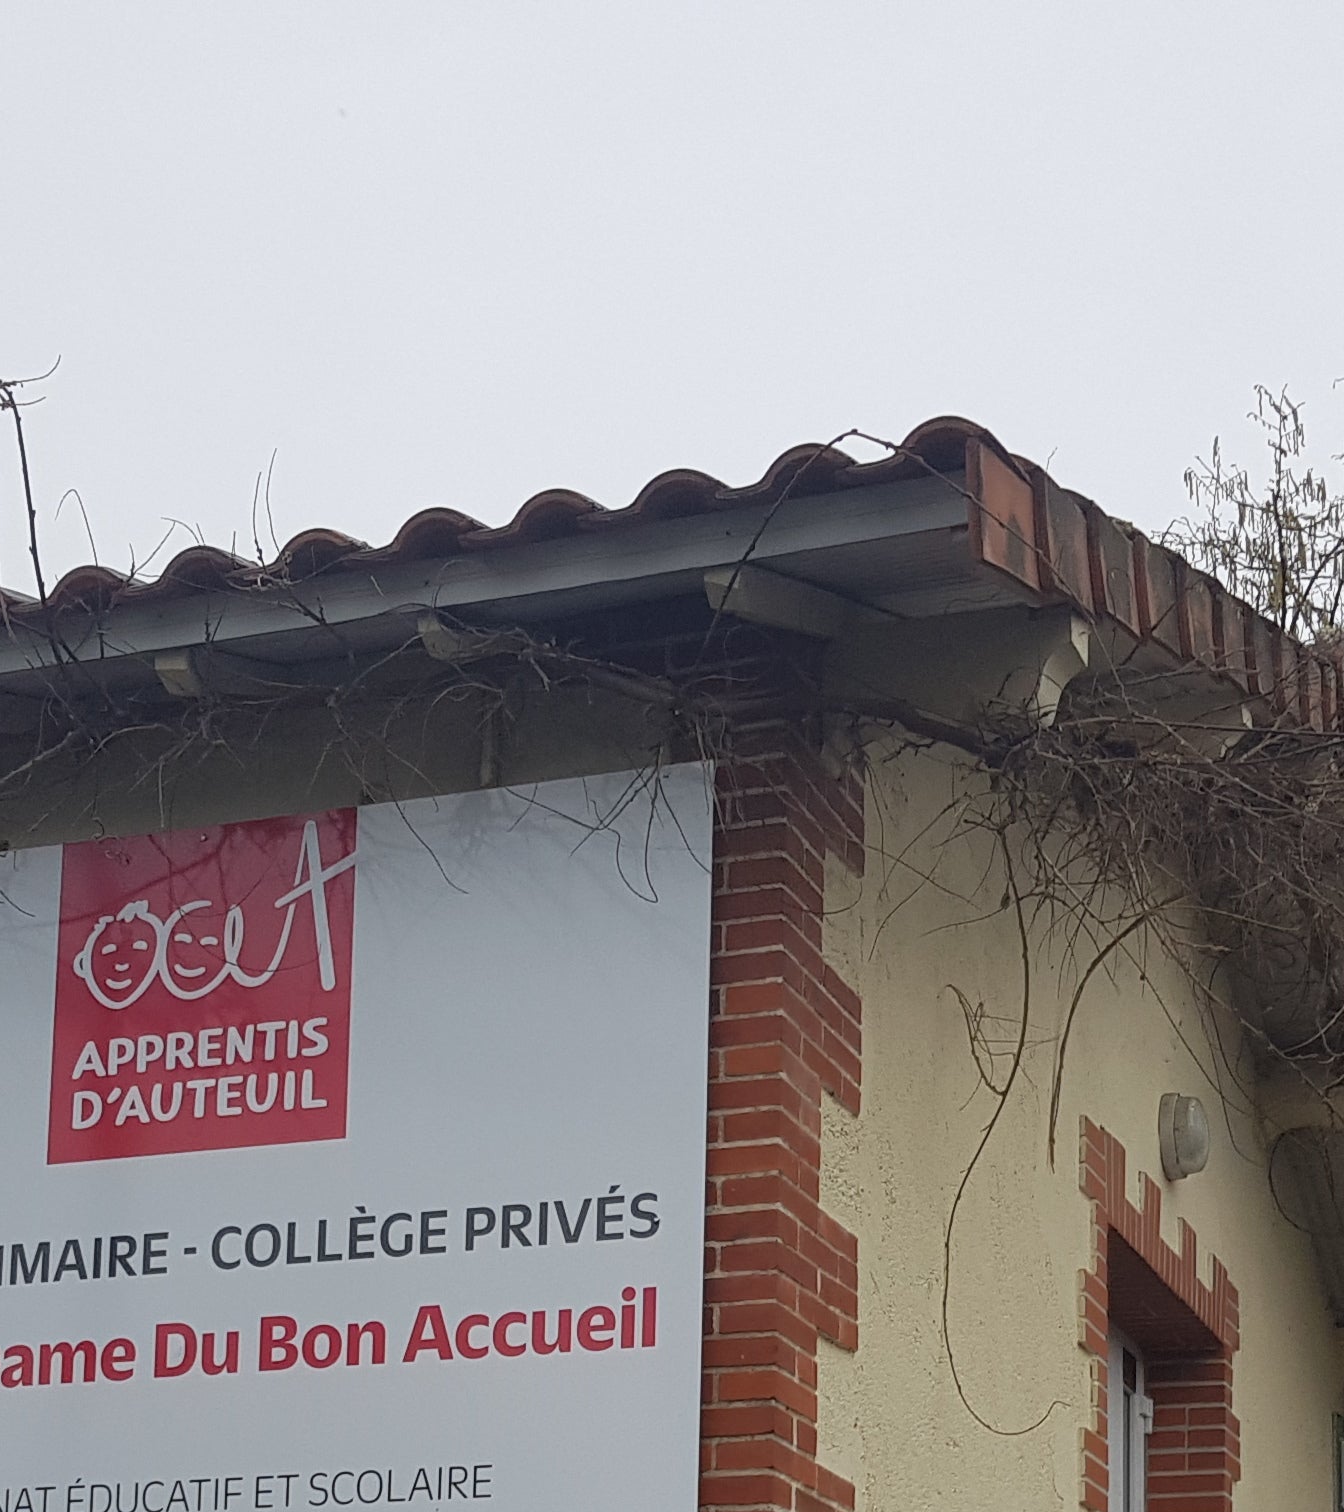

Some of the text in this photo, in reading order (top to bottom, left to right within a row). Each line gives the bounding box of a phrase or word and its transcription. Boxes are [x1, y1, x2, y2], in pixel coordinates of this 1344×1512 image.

[71, 1017, 329, 1080] APPRENTIS
[71, 1069, 328, 1130] D'AUTEUIL
[211, 1206, 448, 1270] COLLÈGE
[465, 1184, 660, 1251] PRIVÉS
[154, 1322, 240, 1376] Du
[258, 1315, 386, 1371] Bon
[402, 1286, 657, 1363] Accueil
[254, 1474, 299, 1509] ET
[309, 1464, 494, 1506] SCOLAIRE
